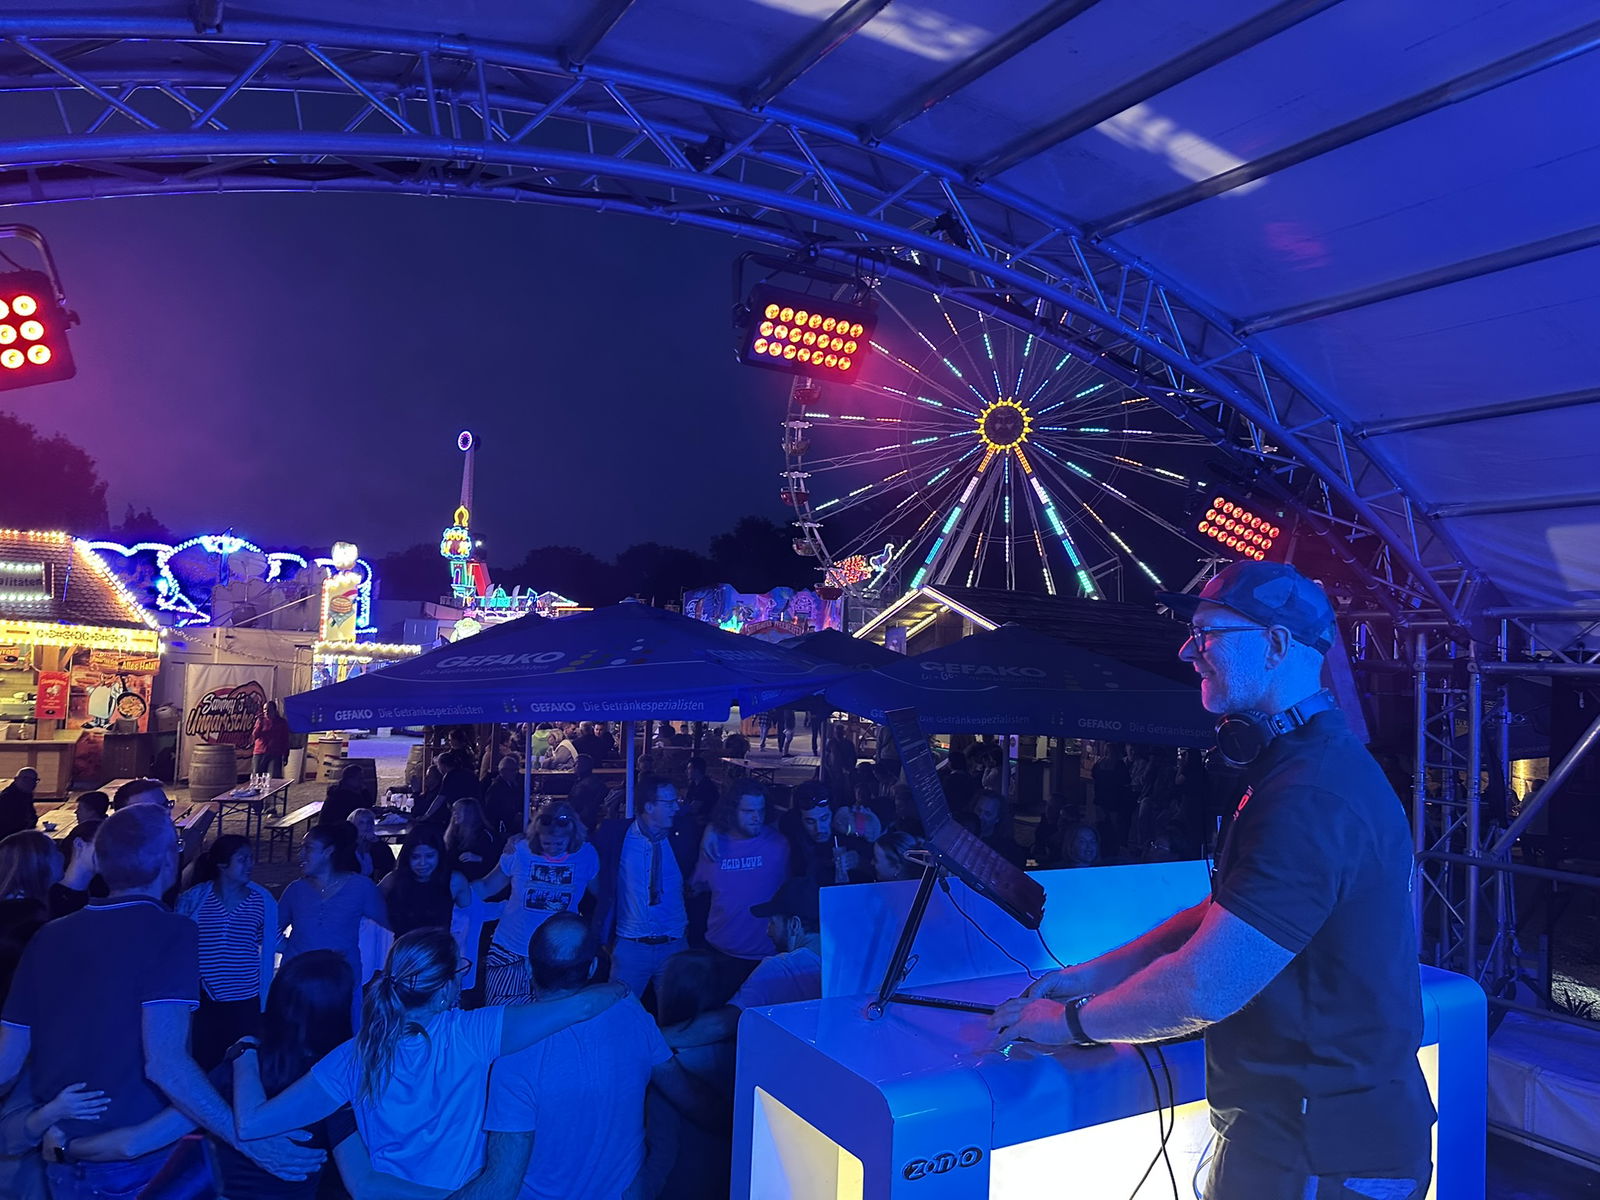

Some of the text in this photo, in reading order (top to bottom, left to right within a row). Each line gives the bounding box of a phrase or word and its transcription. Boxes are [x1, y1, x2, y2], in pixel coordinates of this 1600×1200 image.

[436, 651, 566, 668] GEFAKO
[919, 661, 1047, 678] GEFAKO
[530, 698, 705, 713] GEFAKO Die Getränkespezialisten
[334, 709, 373, 721] GEFAKO
[378, 707, 392, 719] Die
[1078, 718, 1122, 731] GEFAKO
[720, 856, 762, 870] ACID LOVE
